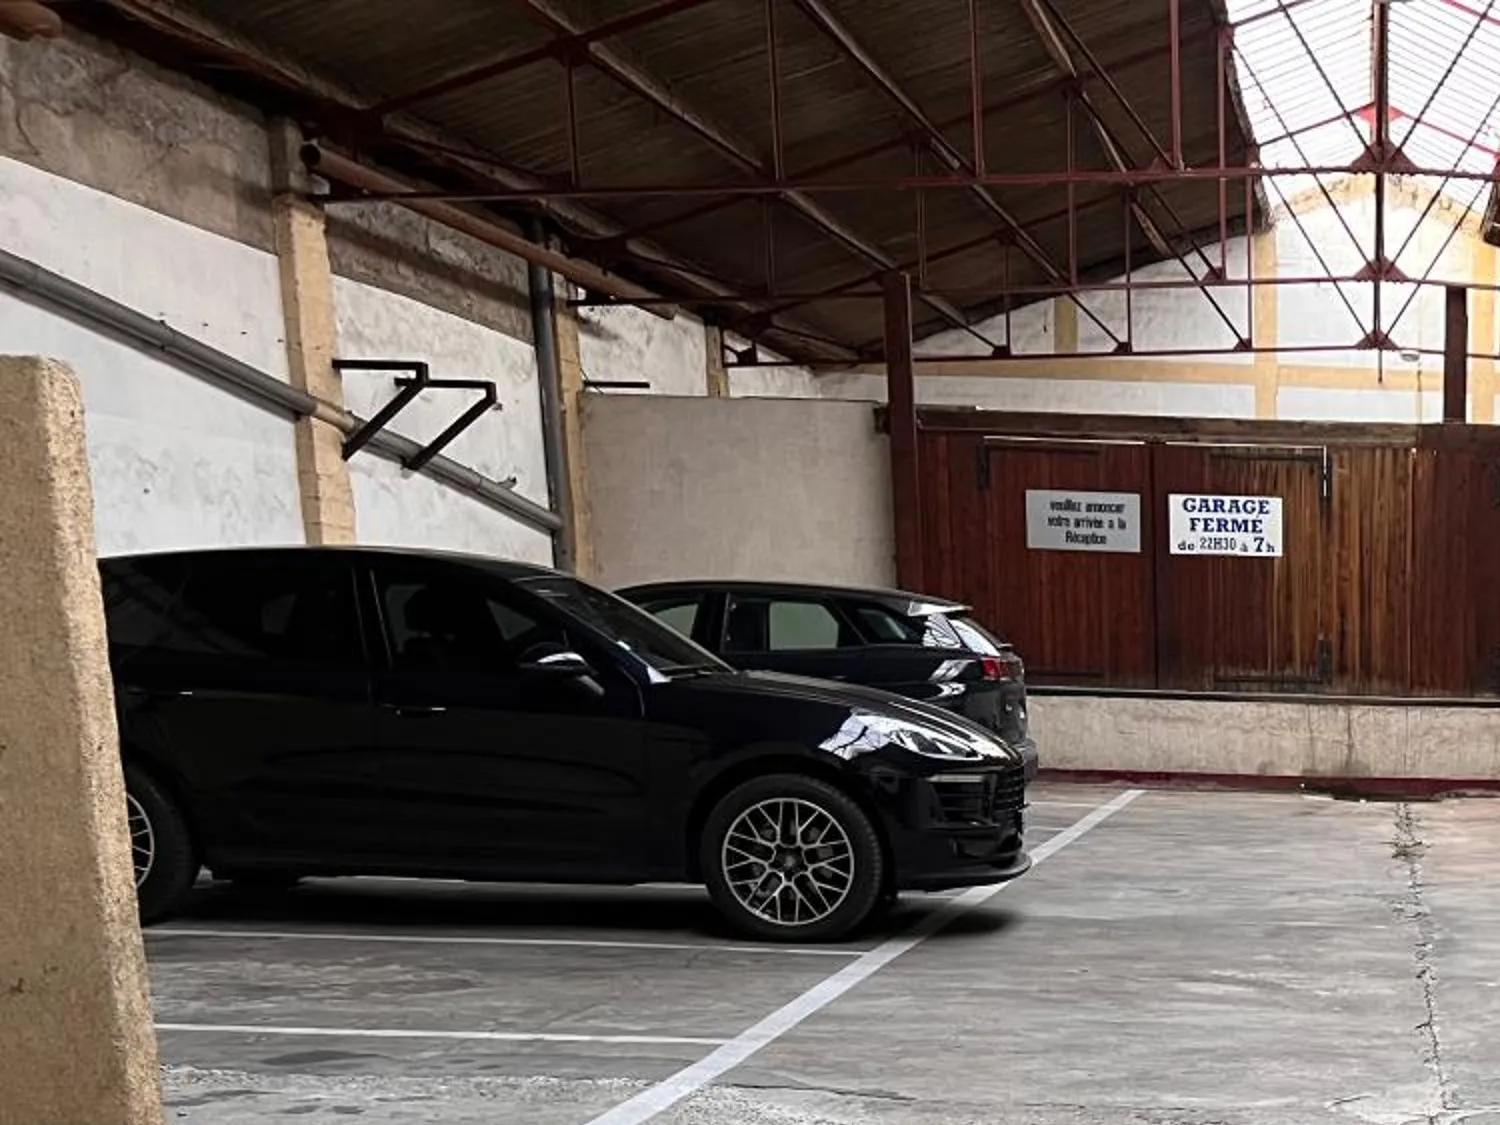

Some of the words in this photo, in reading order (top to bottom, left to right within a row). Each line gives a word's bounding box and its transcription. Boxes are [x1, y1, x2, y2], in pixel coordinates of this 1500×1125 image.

[1085, 503, 1126, 514] annoncer
[1182, 497, 1270, 515] GARAGE
[1047, 515, 1071, 527] votre
[1118, 517, 1127, 530] la
[1189, 515, 1263, 533] FERMÉ
[1065, 530, 1107, 545] Réception
[1178, 540, 1195, 551] de
[1200, 536, 1237, 551] 22H30
